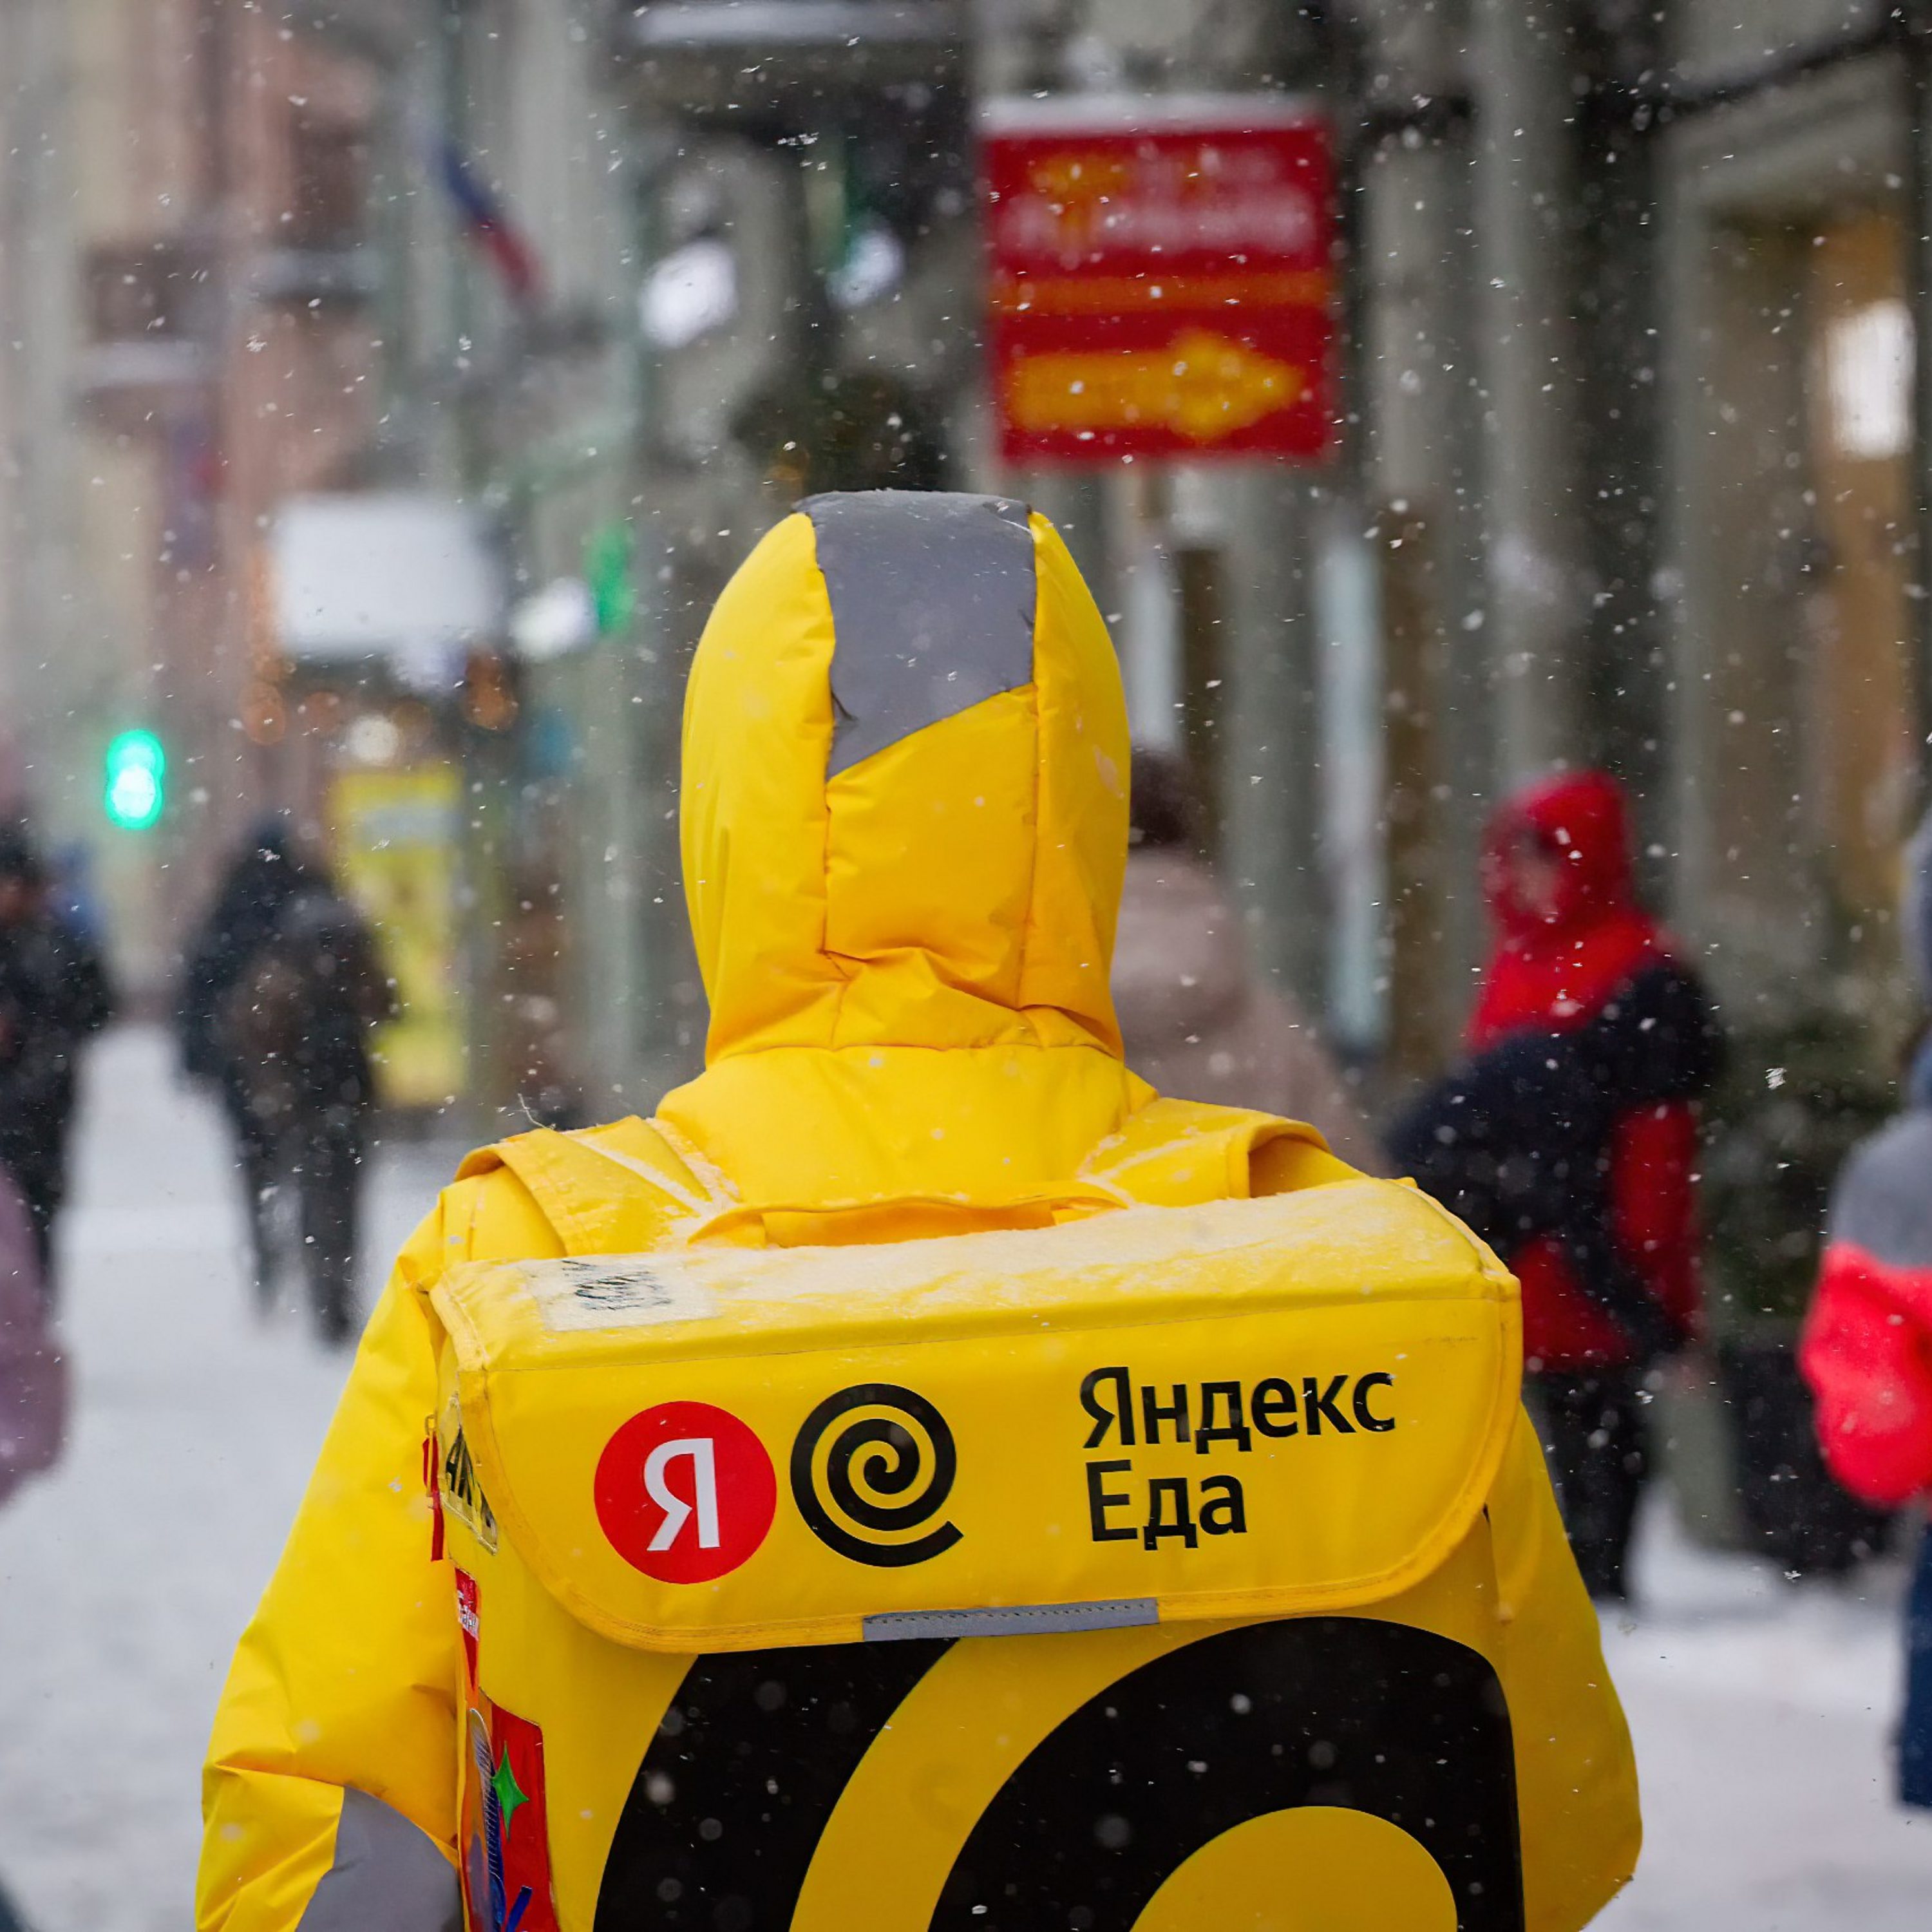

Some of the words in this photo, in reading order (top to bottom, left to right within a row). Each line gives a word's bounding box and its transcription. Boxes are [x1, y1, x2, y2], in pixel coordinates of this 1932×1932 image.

[1079, 1367, 1396, 1455] Яндекс
[644, 1437, 721, 1551] Я
[1086, 1459, 1248, 1551] Еда
